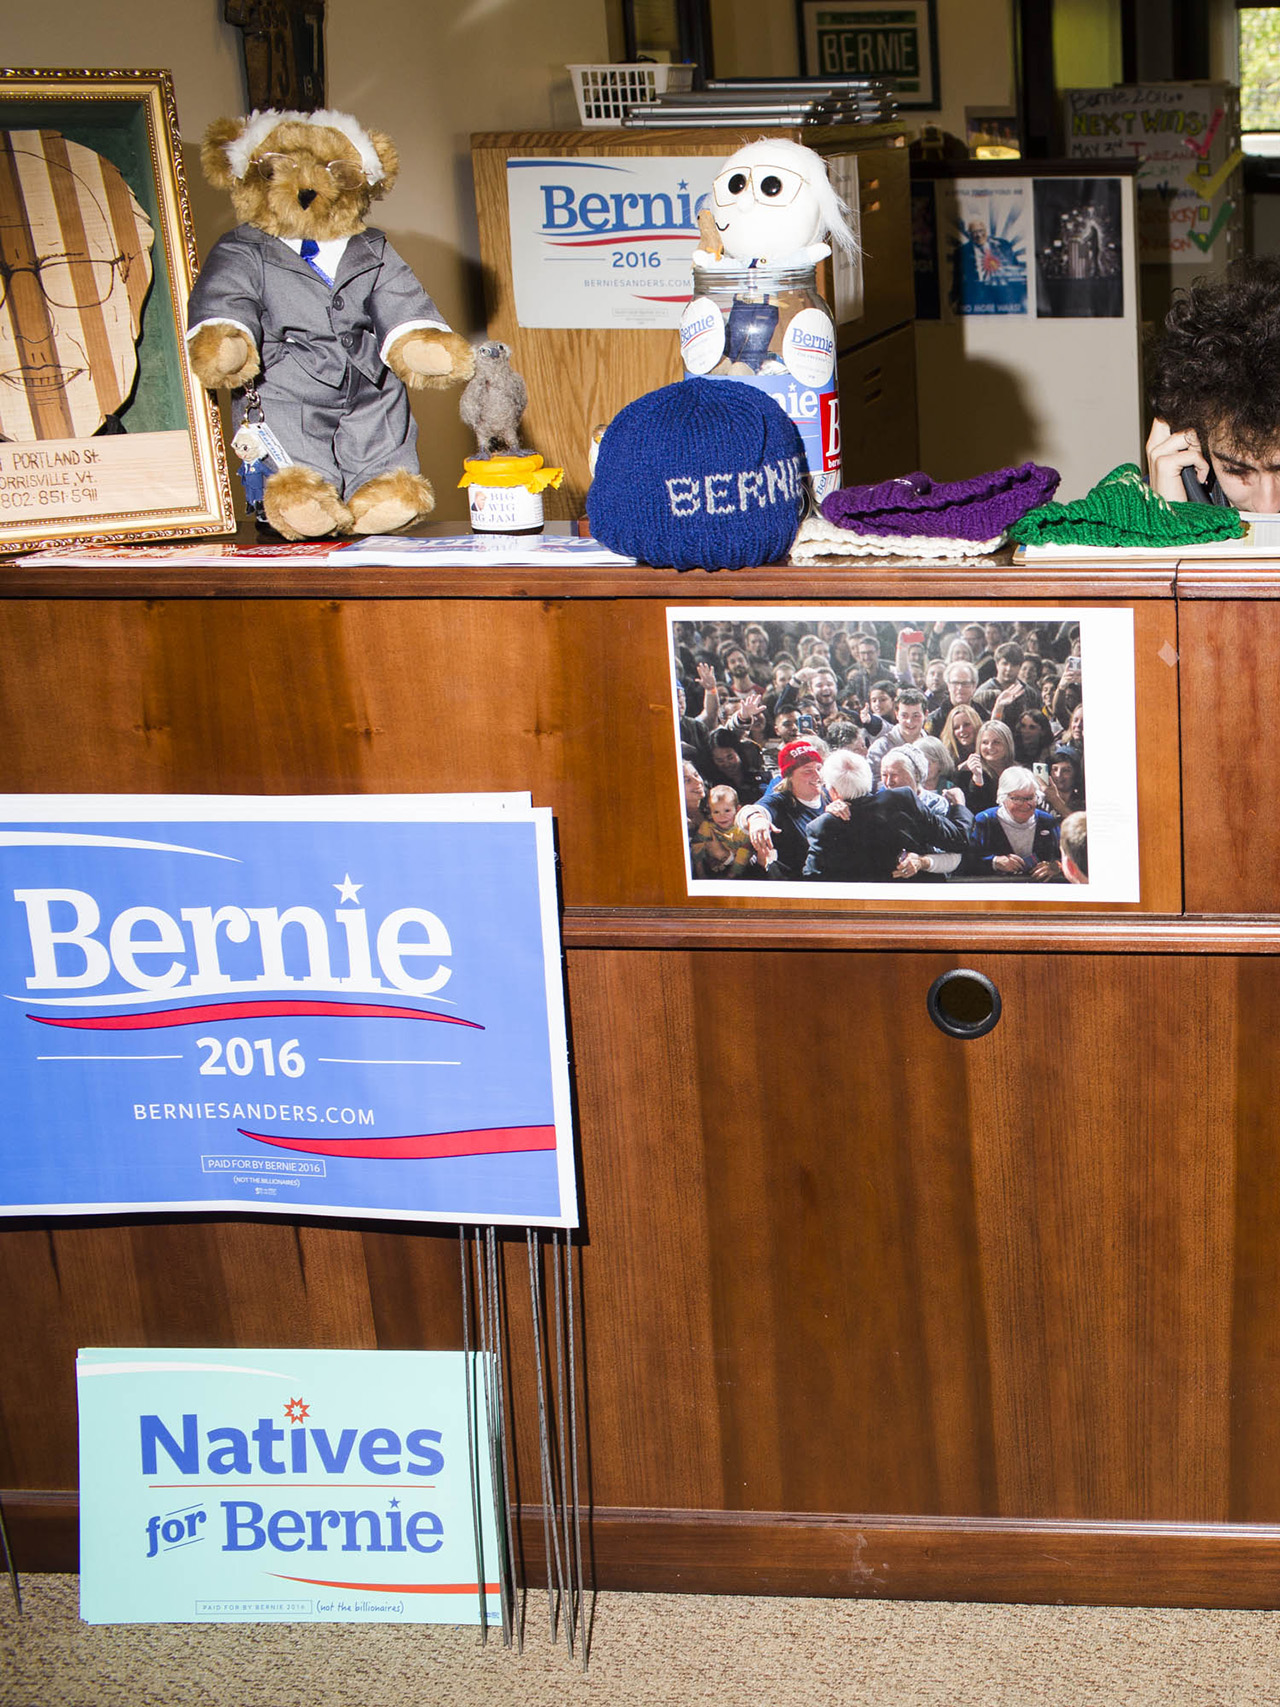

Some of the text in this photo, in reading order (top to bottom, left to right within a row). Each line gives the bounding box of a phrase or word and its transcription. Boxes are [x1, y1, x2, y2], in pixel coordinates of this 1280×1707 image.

[822, 32, 915, 74] BERNIE
[1072, 112, 1137, 136] NEXT
[612, 252, 661, 268] 2016
[584, 279, 691, 288] BERNIESANDERS.COM
[792, 327, 833, 353] Bernie
[13, 450, 81, 470] PORTLAND
[489, 503, 515, 511] WIG
[490, 493, 514, 501] BIG
[489, 513, 515, 523] JAM
[13, 874, 453, 996] Bernie
[196, 1037, 306, 1078] 2016
[133, 1102, 376, 1127] BERNIESANDERS.COM
[208, 1159, 321, 1173] PAID FOR BY BERNIE 2016
[249, 1176, 260, 1184] THE
[140, 1397, 445, 1475] Natives
[145, 1497, 445, 1558] for Bernie
[316, 1599, 405, 1614] (not the billionaires)
